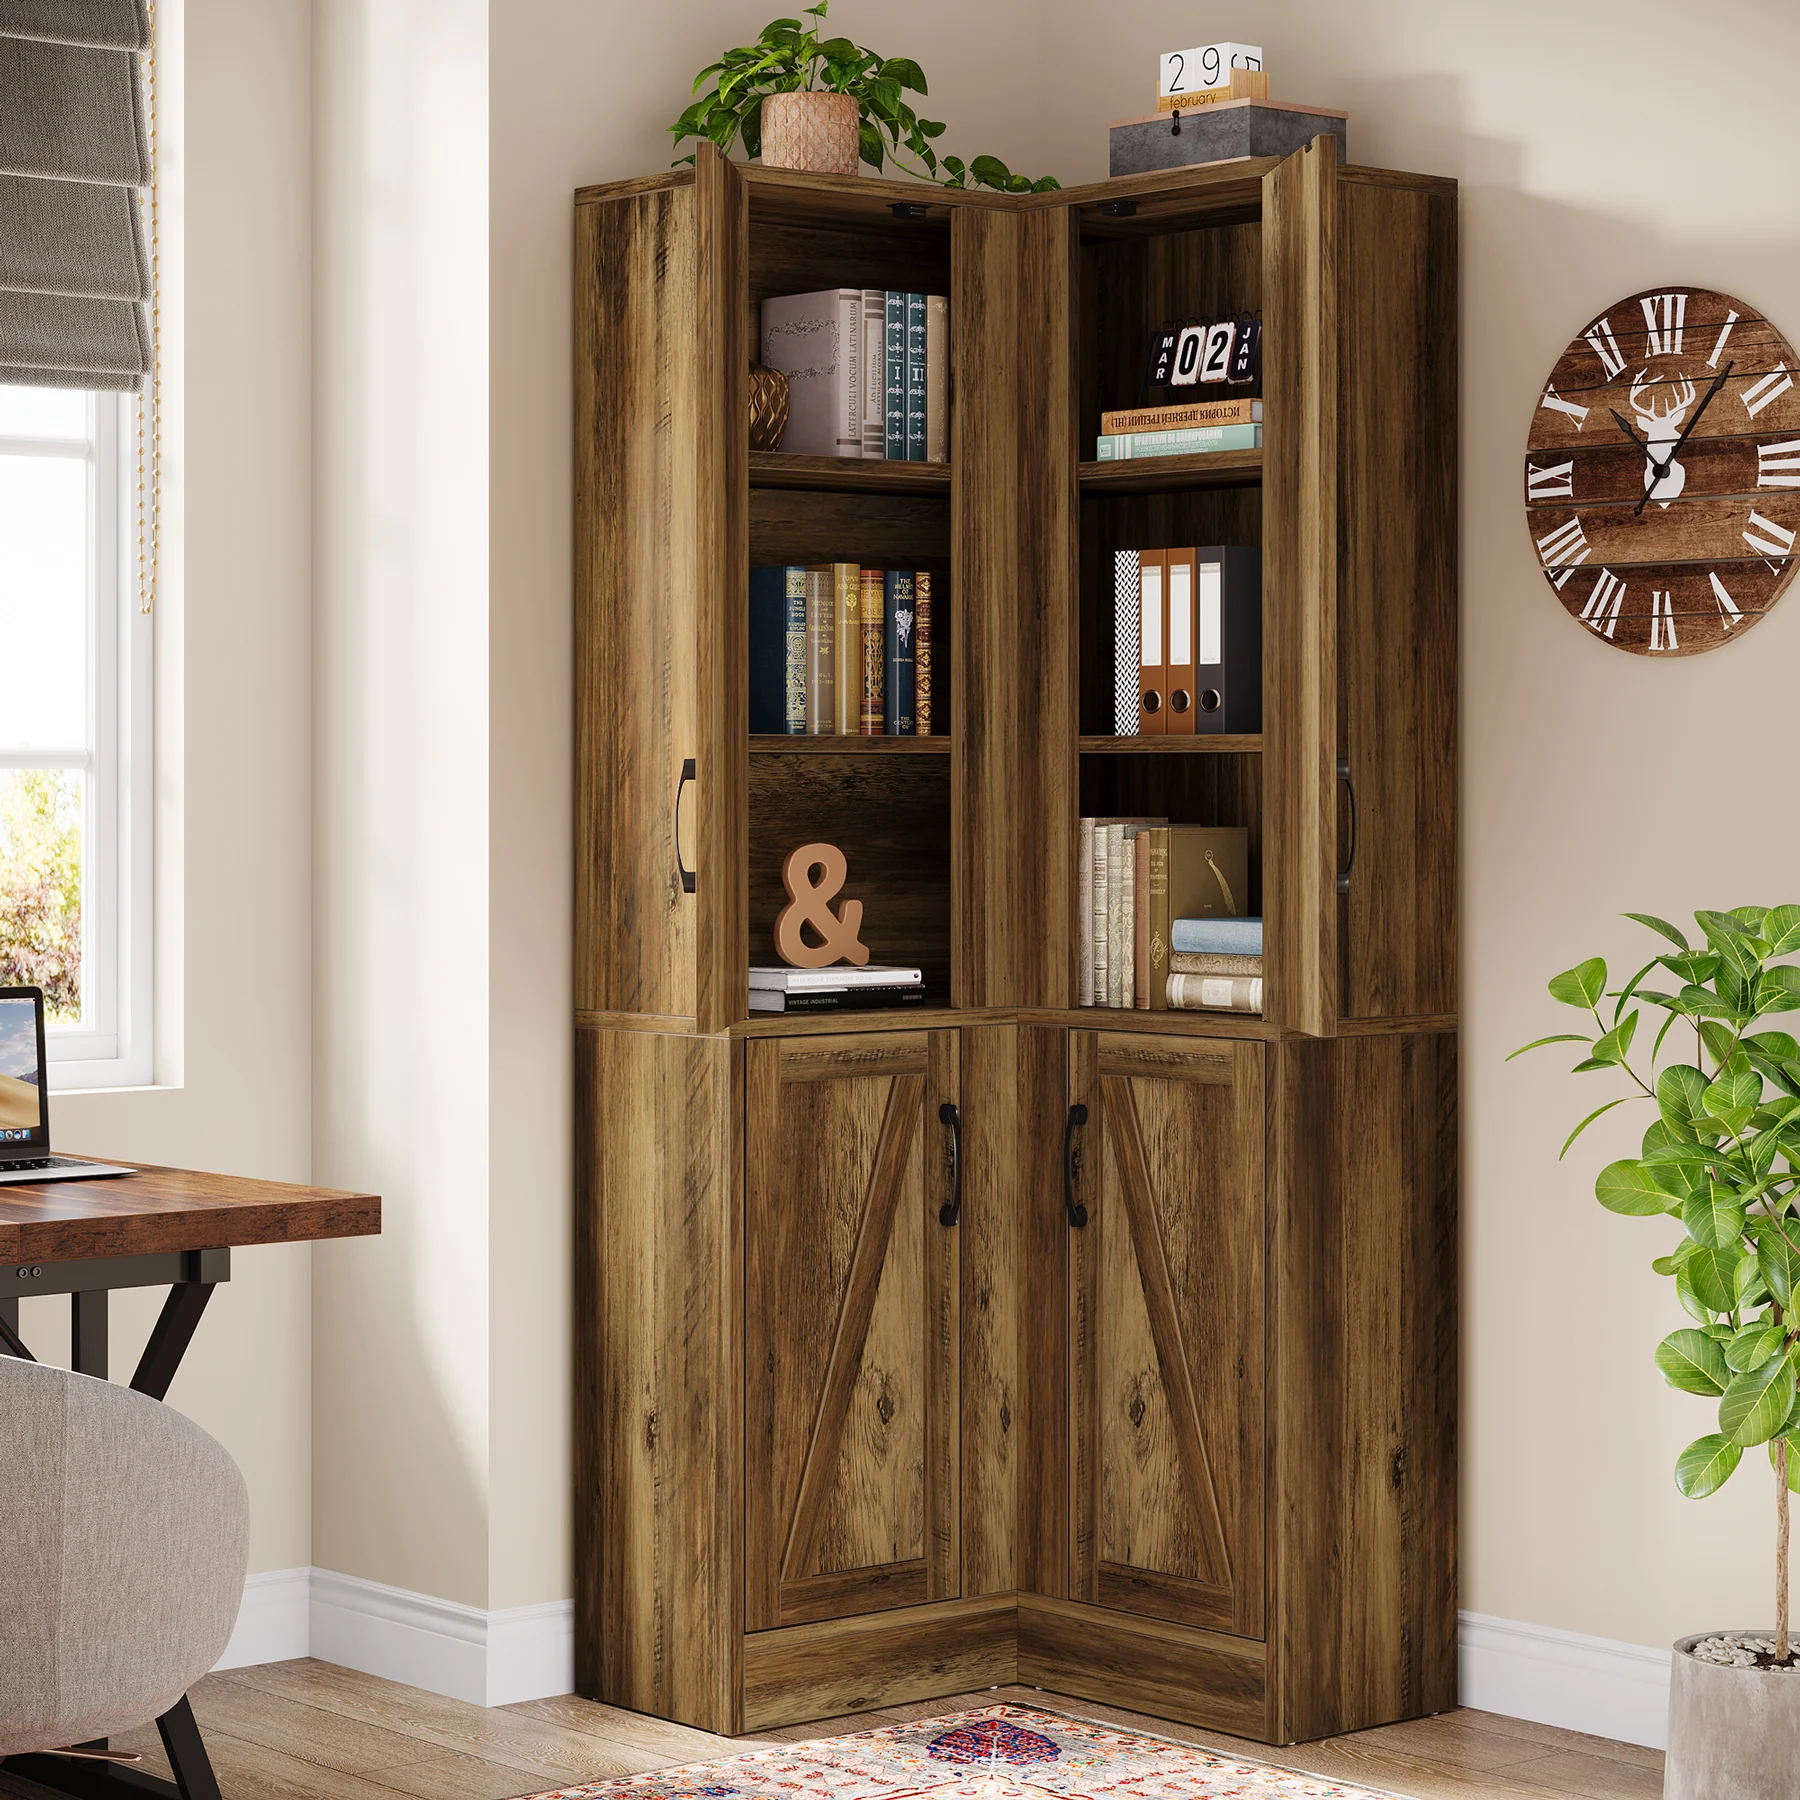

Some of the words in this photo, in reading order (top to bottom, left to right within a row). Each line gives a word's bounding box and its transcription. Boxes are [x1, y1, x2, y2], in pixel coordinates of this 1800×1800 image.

[1169, 91, 1217, 110] february
[848, 302, 858, 353] LATINARUM
[1640, 294, 1688, 358] XII
[1155, 336, 1174, 379] MAR
[1178, 330, 1229, 376] 02
[1237, 326, 1252, 371] JAN
[848, 356, 858, 388] VOCUM
[848, 390, 858, 438] LATERCULI
[1128, 414, 1160, 426] ГРЕЦИИ
[1161, 410, 1198, 425] ДРЕВНЕЙ
[1200, 407, 1240, 420] ИСТОРИЯ
[810, 997, 839, 1005] INDUSTRIAL
